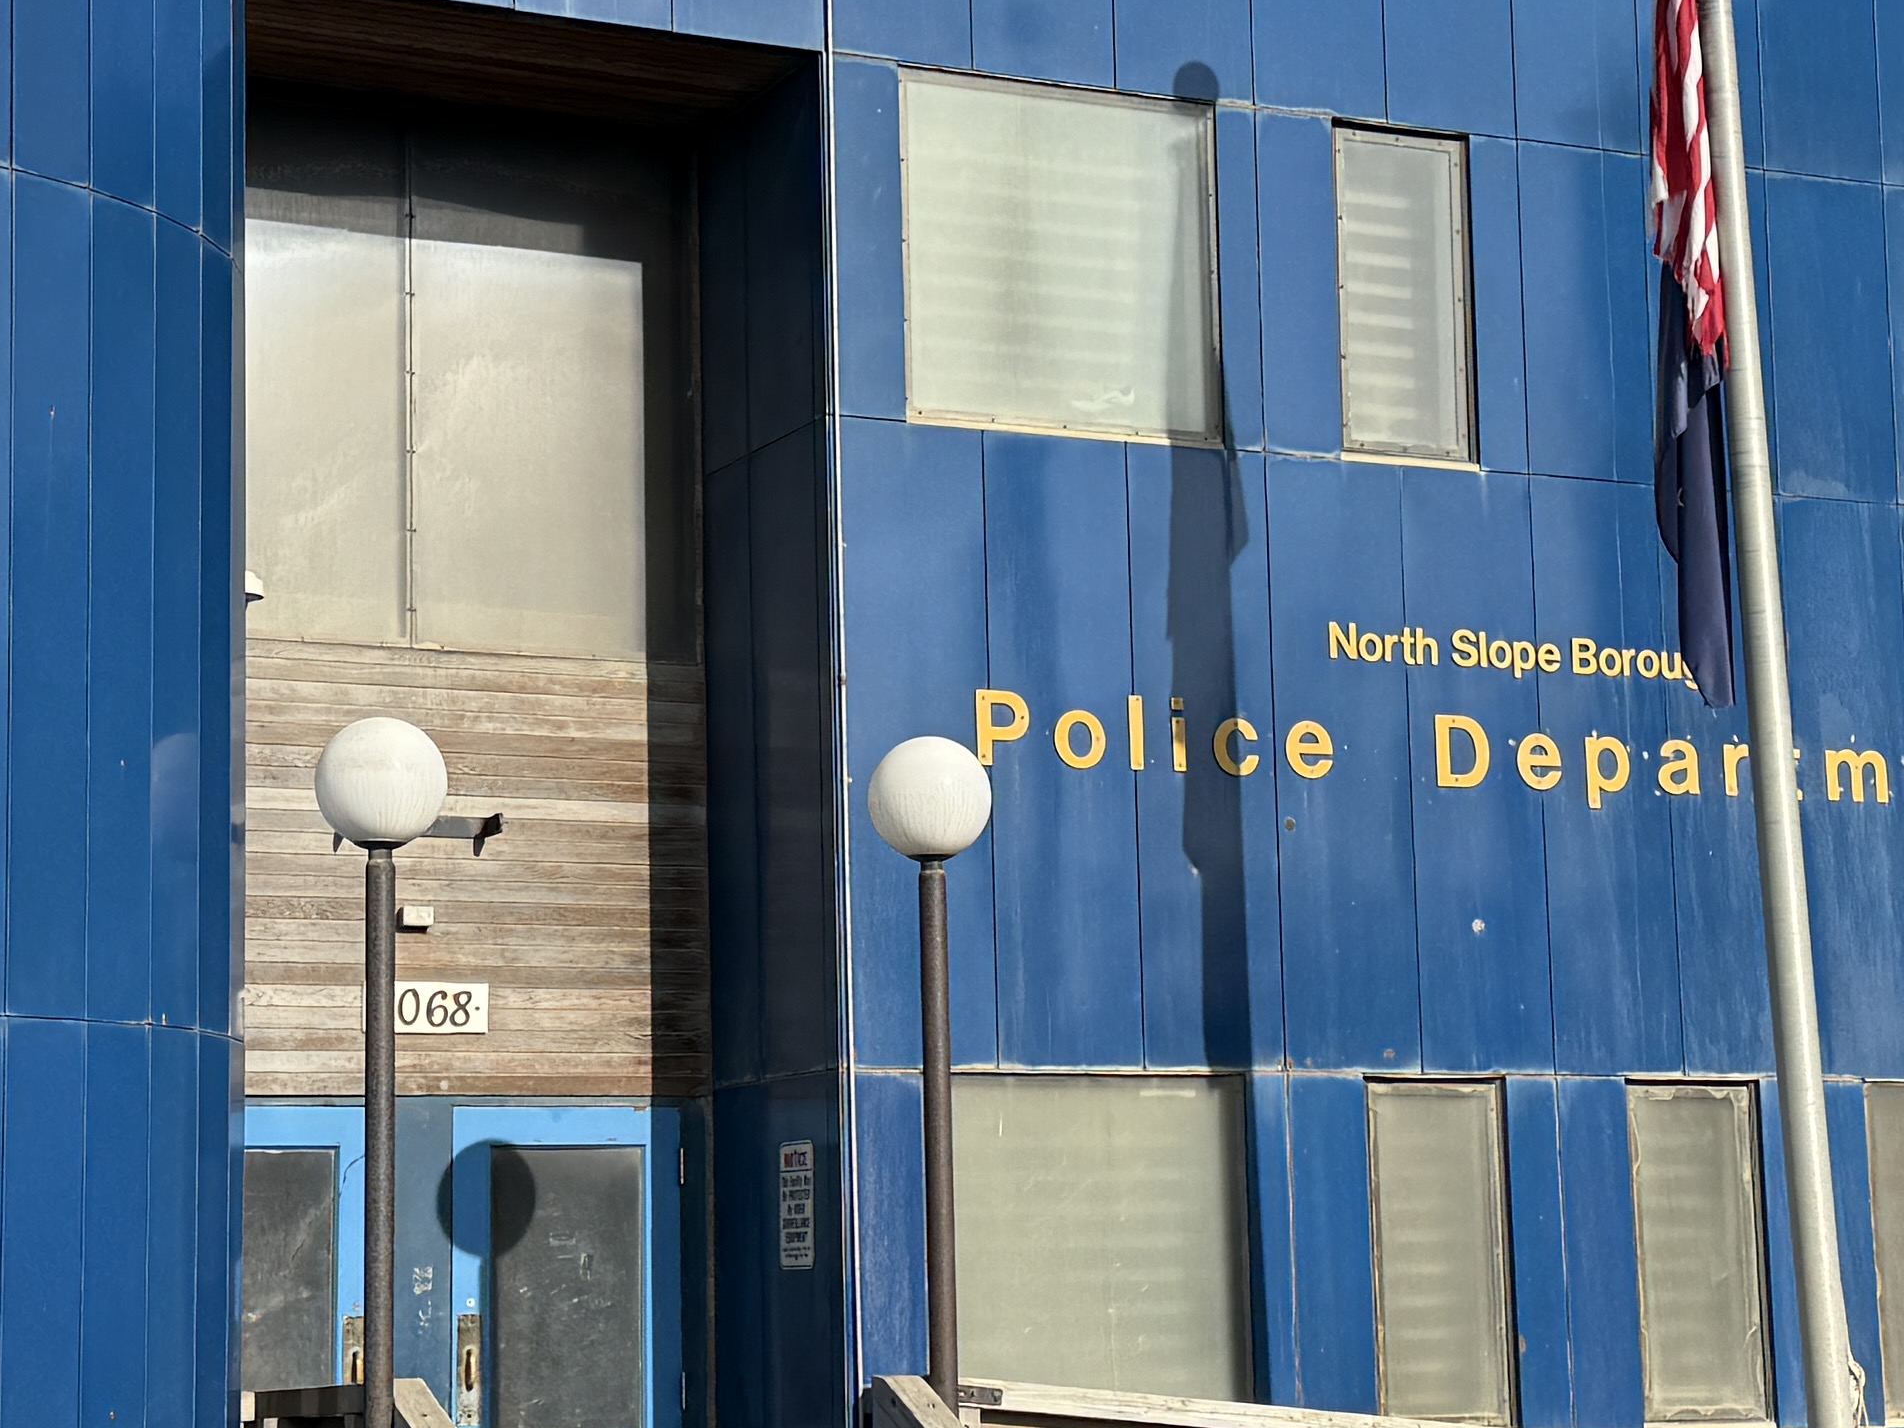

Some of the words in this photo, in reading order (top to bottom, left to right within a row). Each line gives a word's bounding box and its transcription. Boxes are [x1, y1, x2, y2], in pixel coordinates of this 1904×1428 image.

[1327, 621, 1439, 666] North
[1450, 628, 1562, 679] Slope
[1571, 636, 1699, 691] Borou
[975, 688, 1335, 780] Police
[397, 987, 473, 1028] 068
